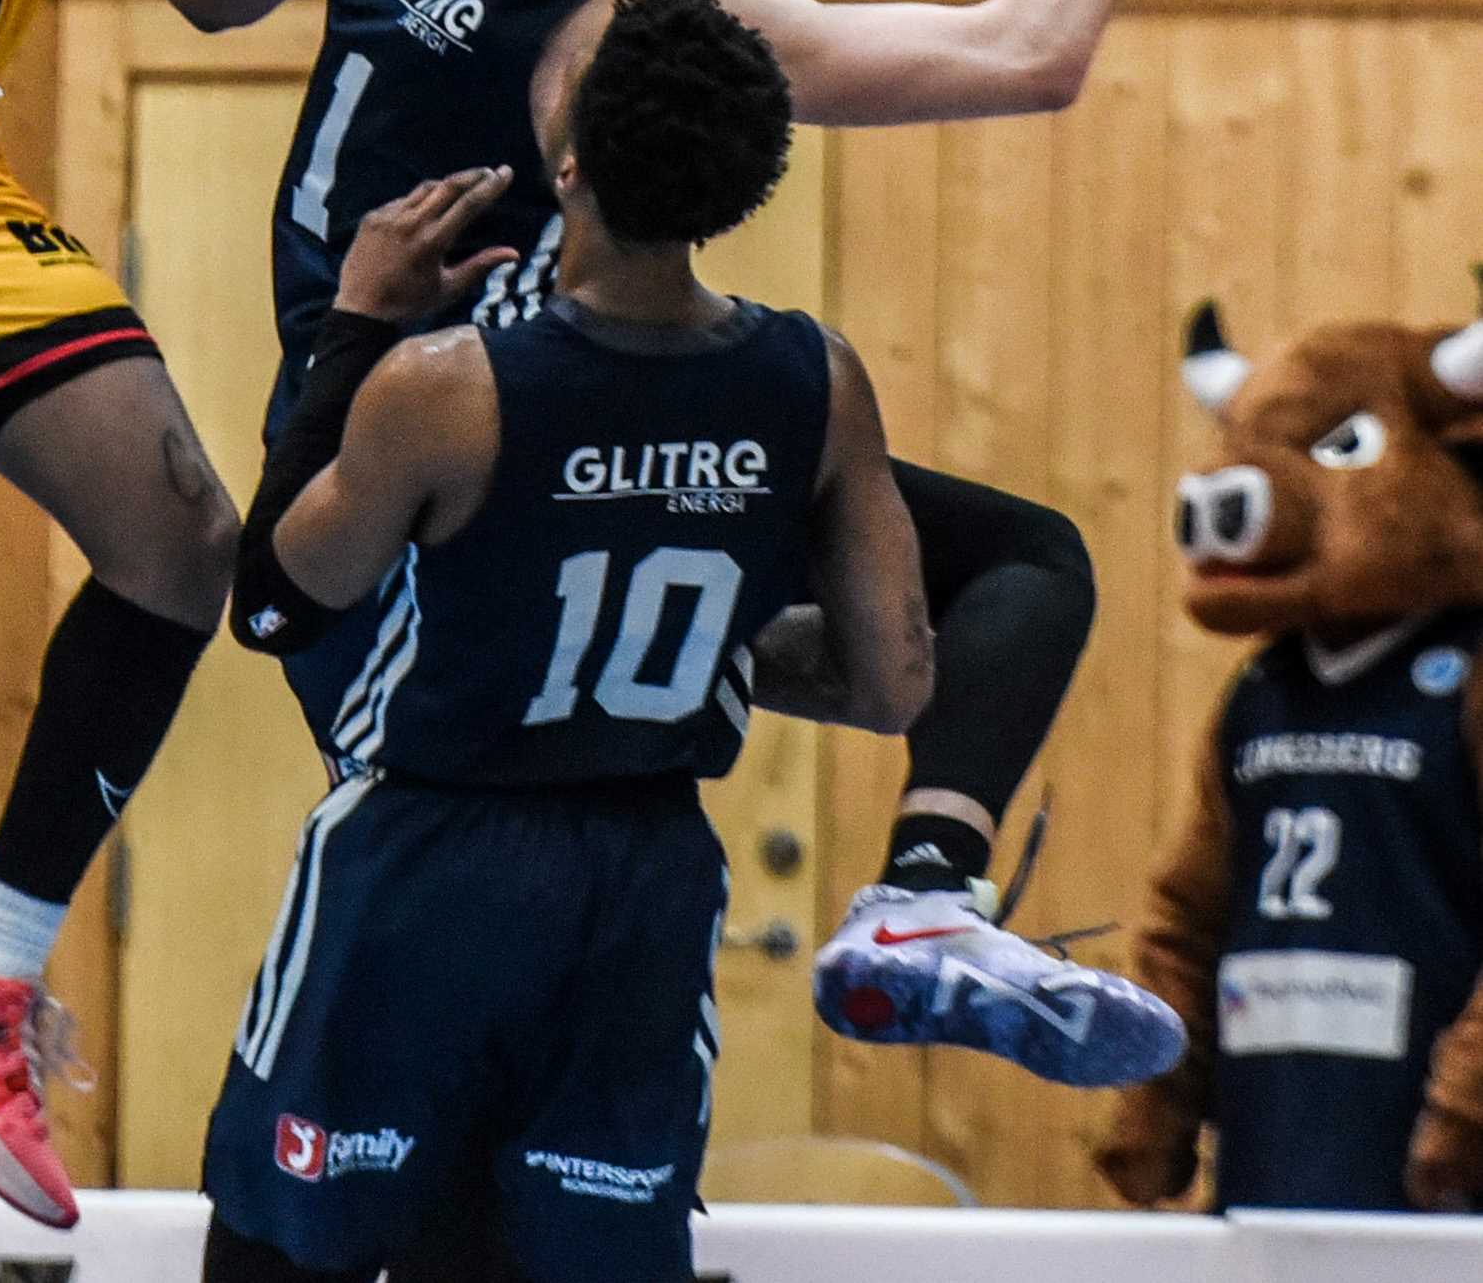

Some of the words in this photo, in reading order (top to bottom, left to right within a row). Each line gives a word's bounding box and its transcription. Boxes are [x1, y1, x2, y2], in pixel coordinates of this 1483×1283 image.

[292, 52, 374, 241] 1
[521, 547, 744, 724] 10
[1257, 806, 1343, 919] 22
